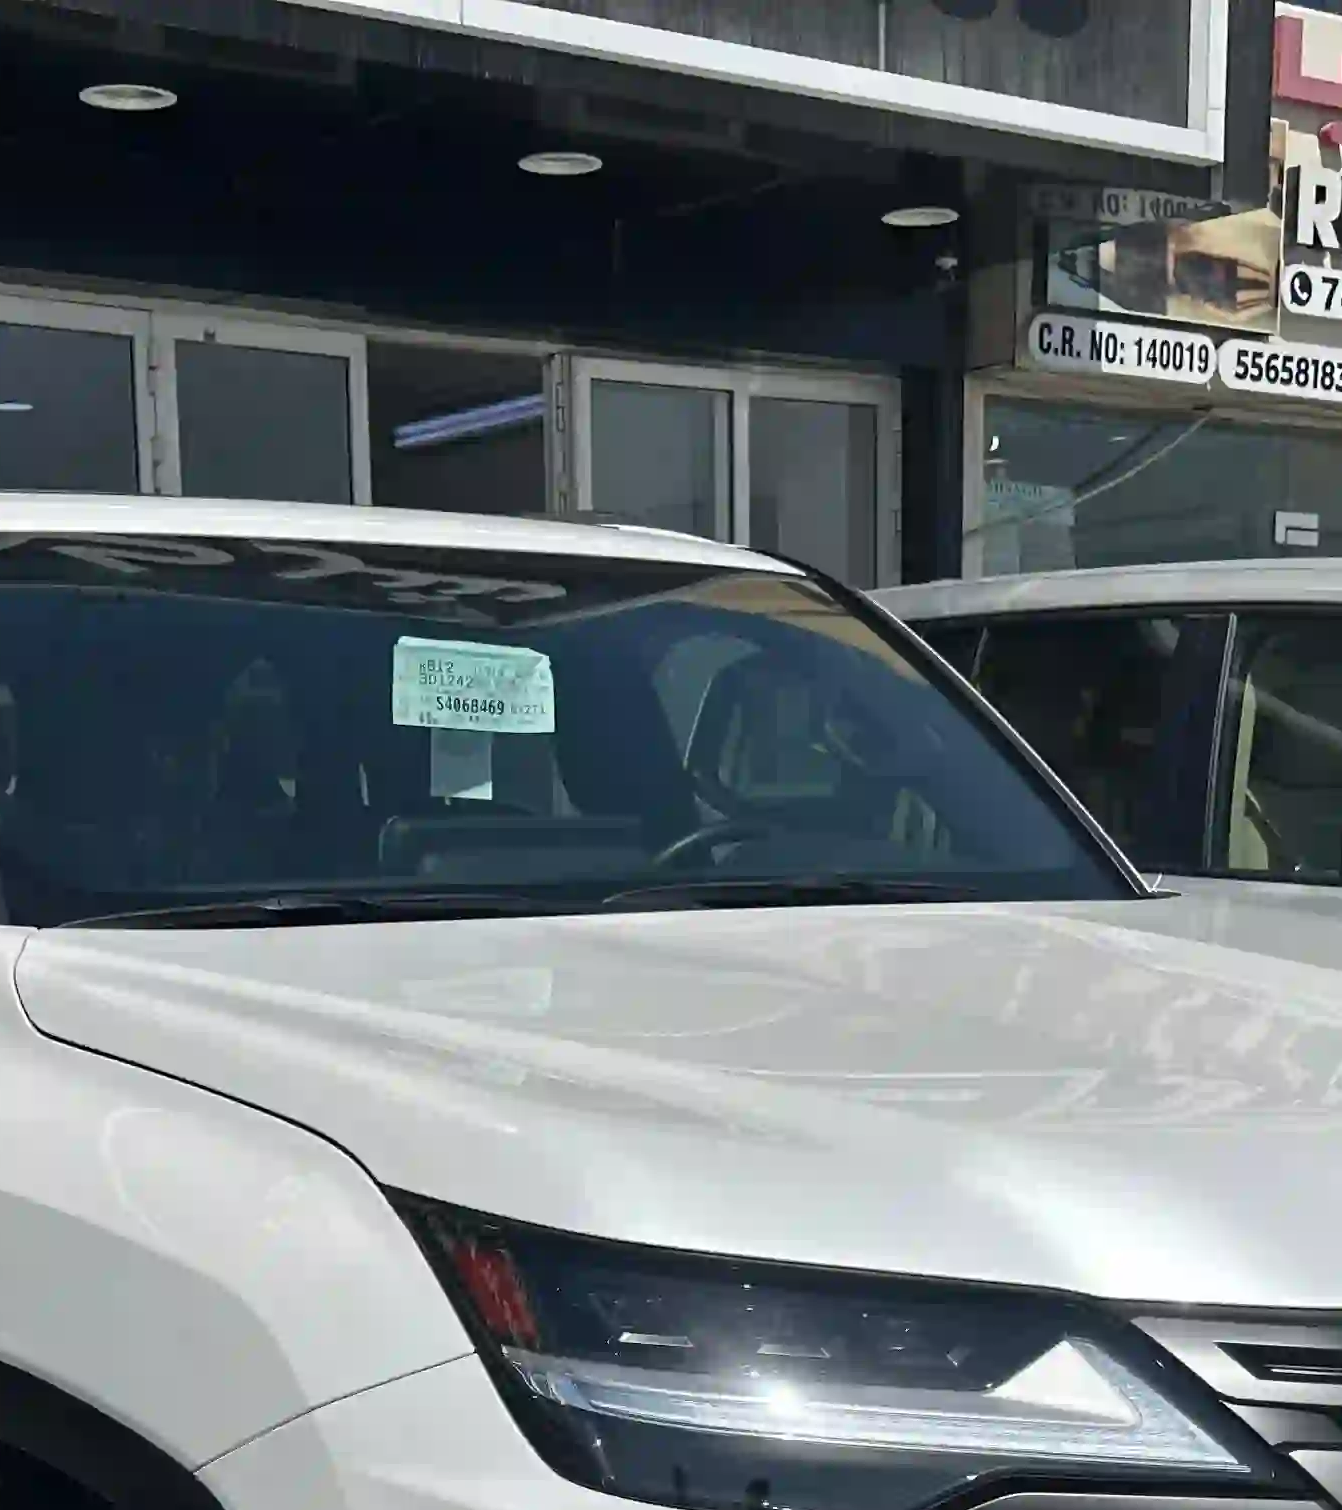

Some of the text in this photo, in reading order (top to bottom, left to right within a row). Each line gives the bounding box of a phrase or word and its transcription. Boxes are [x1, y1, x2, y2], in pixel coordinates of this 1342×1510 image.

[1037, 321, 1209, 374] C.R. NO: 140019
